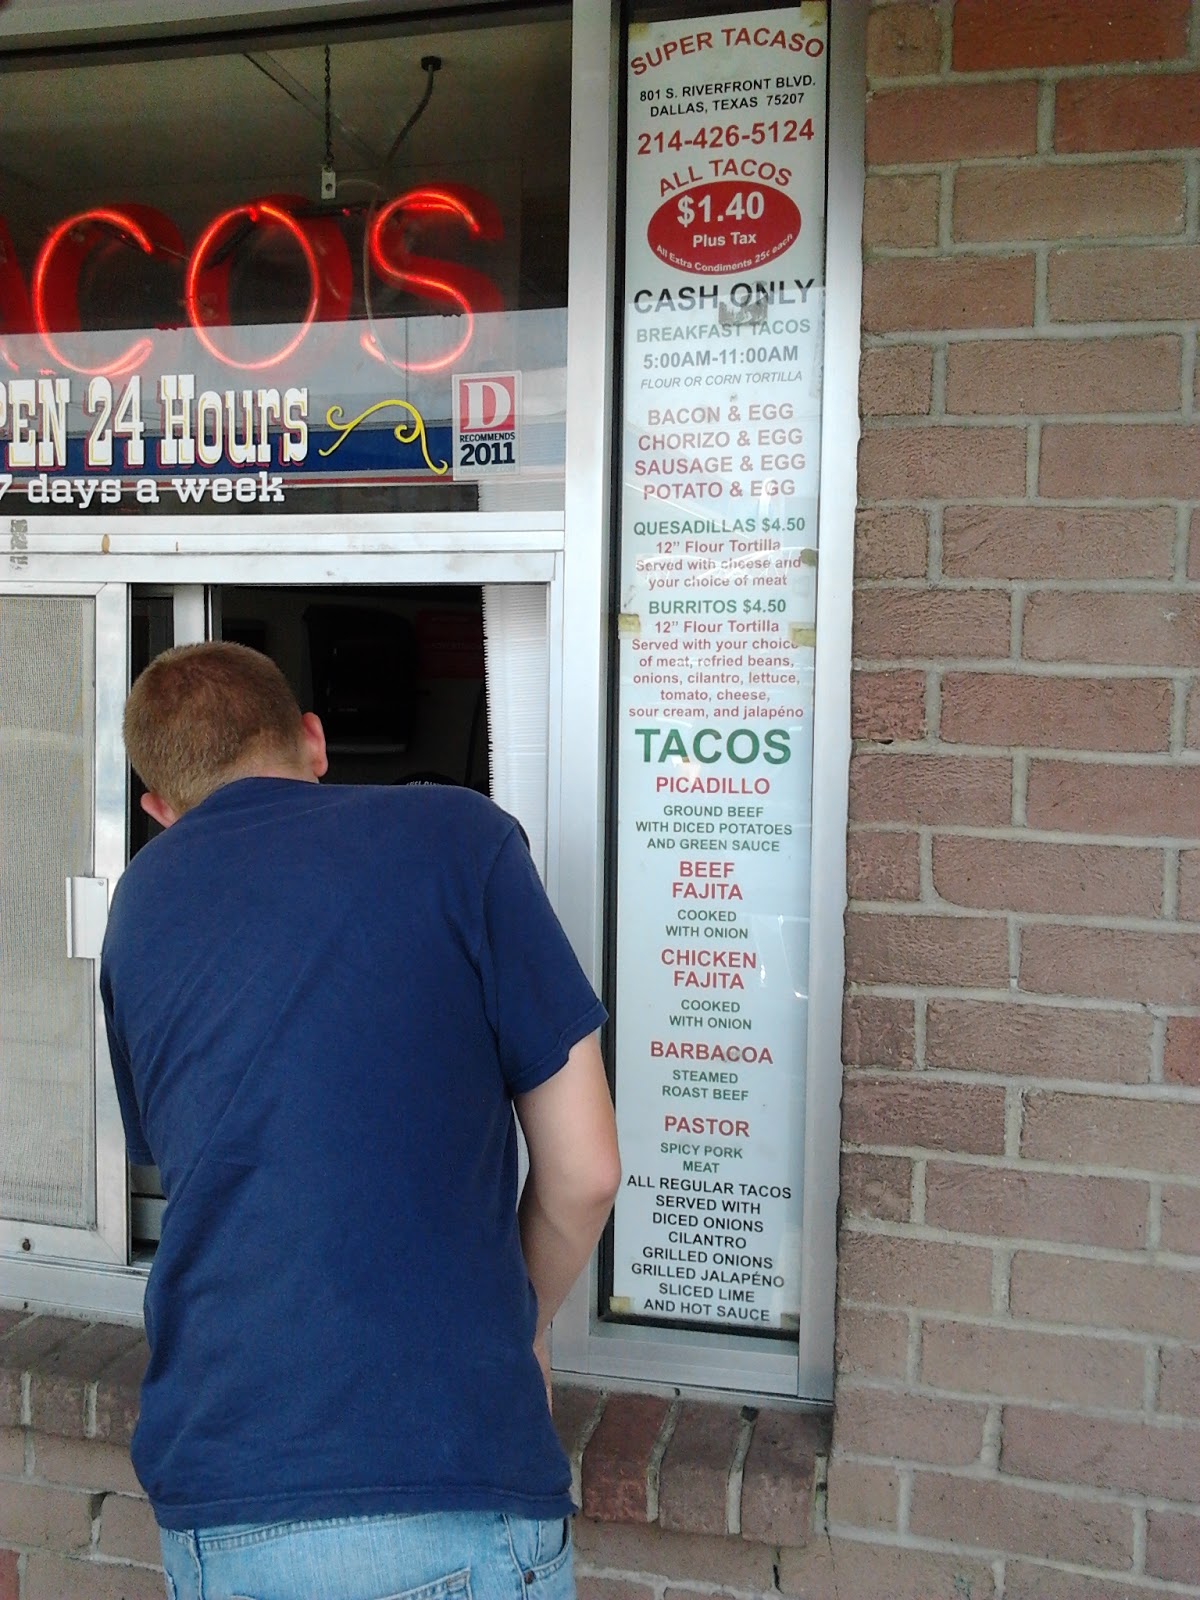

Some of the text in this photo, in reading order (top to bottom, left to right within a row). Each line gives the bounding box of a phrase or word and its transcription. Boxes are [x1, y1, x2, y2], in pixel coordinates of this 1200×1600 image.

[630, 27, 824, 76] SUPER TACASO
[640, 75, 816, 102] 801 S. RIVERFRONT BLVD.
[650, 93, 804, 117] DALLAS, TEXAS 75207
[637, 118, 814, 155] 214-426-5124
[660, 159, 793, 197] ALL TACOS
[677, 191, 764, 228] $1.40
[692, 231, 756, 248] Plus Tax
[657, 244, 667, 258] All
[670, 253, 692, 268] Extra
[695, 259, 752, 271] Condiments
[772, 234, 792, 253] each
[0, 184, 498, 376] COS
[634, 278, 815, 313] CASH ONLY
[637, 319, 810, 343] BREAKFAST TACOS
[644, 346, 798, 369] 5:00AM-11:00AM
[641, 371, 802, 389] FLOUR OR CORN TORTILLA
[463, 381, 511, 430] D
[648, 403, 793, 425] BACON & EGG
[0, 374, 308, 467] EN 24 Hours
[460, 432, 515, 442] RECOMMENDS
[638, 428, 803, 450] CHORIZO & EGG
[460, 442, 515, 466] 2011
[635, 454, 806, 476] SAUSAGE & EGG
[27, 473, 122, 509] days
[136, 477, 160, 504] a
[171, 471, 285, 504] week
[644, 480, 795, 500] POTATO & EGG
[634, 518, 805, 536] QUESADILLAS $4.50
[685, 541, 724, 553] Flour
[729, 539, 781, 552] Tortilla
[636, 557, 801, 572] Served with cheese and
[649, 575, 787, 591] your choice of meat
[649, 599, 786, 615] BURRITOS $4.50
[684, 621, 723, 633] Flour
[728, 620, 779, 632] Tortilla
[632, 639, 678, 650] Served
[682, 639, 711, 649] with
[716, 640, 747, 652] your
[639, 655, 794, 669] of meat, refried beans,
[633, 672, 800, 685] onions, cilantro, lettuce,
[660, 689, 770, 702] tomato, cheese,
[629, 706, 804, 720] sour cream, and jalapéno
[635, 728, 791, 764] TACOS
[656, 777, 770, 794] PICADILLO
[663, 805, 764, 818] GROUND BEEF
[635, 821, 792, 835] WITH DICED POTATOES
[647, 839, 780, 852] AND GREEN SAUCE
[680, 861, 734, 878] BEEF
[672, 882, 743, 900] FAJITA
[677, 910, 737, 922] COOKED
[666, 926, 748, 939] WITH ONION
[661, 949, 756, 968] CHICKEN
[674, 971, 744, 989] FAJITA
[681, 1000, 740, 1012] COOKED
[669, 1015, 752, 1030] WITH ONION
[651, 1041, 773, 1064] BARBACOA
[672, 1070, 738, 1084] STEAMED
[662, 1086, 749, 1101] ROAST BEEF
[664, 1116, 750, 1138] PASTOR
[660, 1143, 743, 1159] SPICY PORK
[683, 1161, 720, 1174] MEAT
[627, 1175, 791, 1199] ALL REGULAR TACOS
[656, 1195, 761, 1214] SERVED WITH
[652, 1212, 763, 1232] DICED ONIONS
[668, 1231, 747, 1249] CILANTRO
[642, 1247, 773, 1269] GRILLED ONIONS
[632, 1263, 784, 1288] GRILLED JALAPÉNO
[659, 1283, 755, 1302] SLICED LIME
[644, 1299, 770, 1321] AND HOT SAUCE
